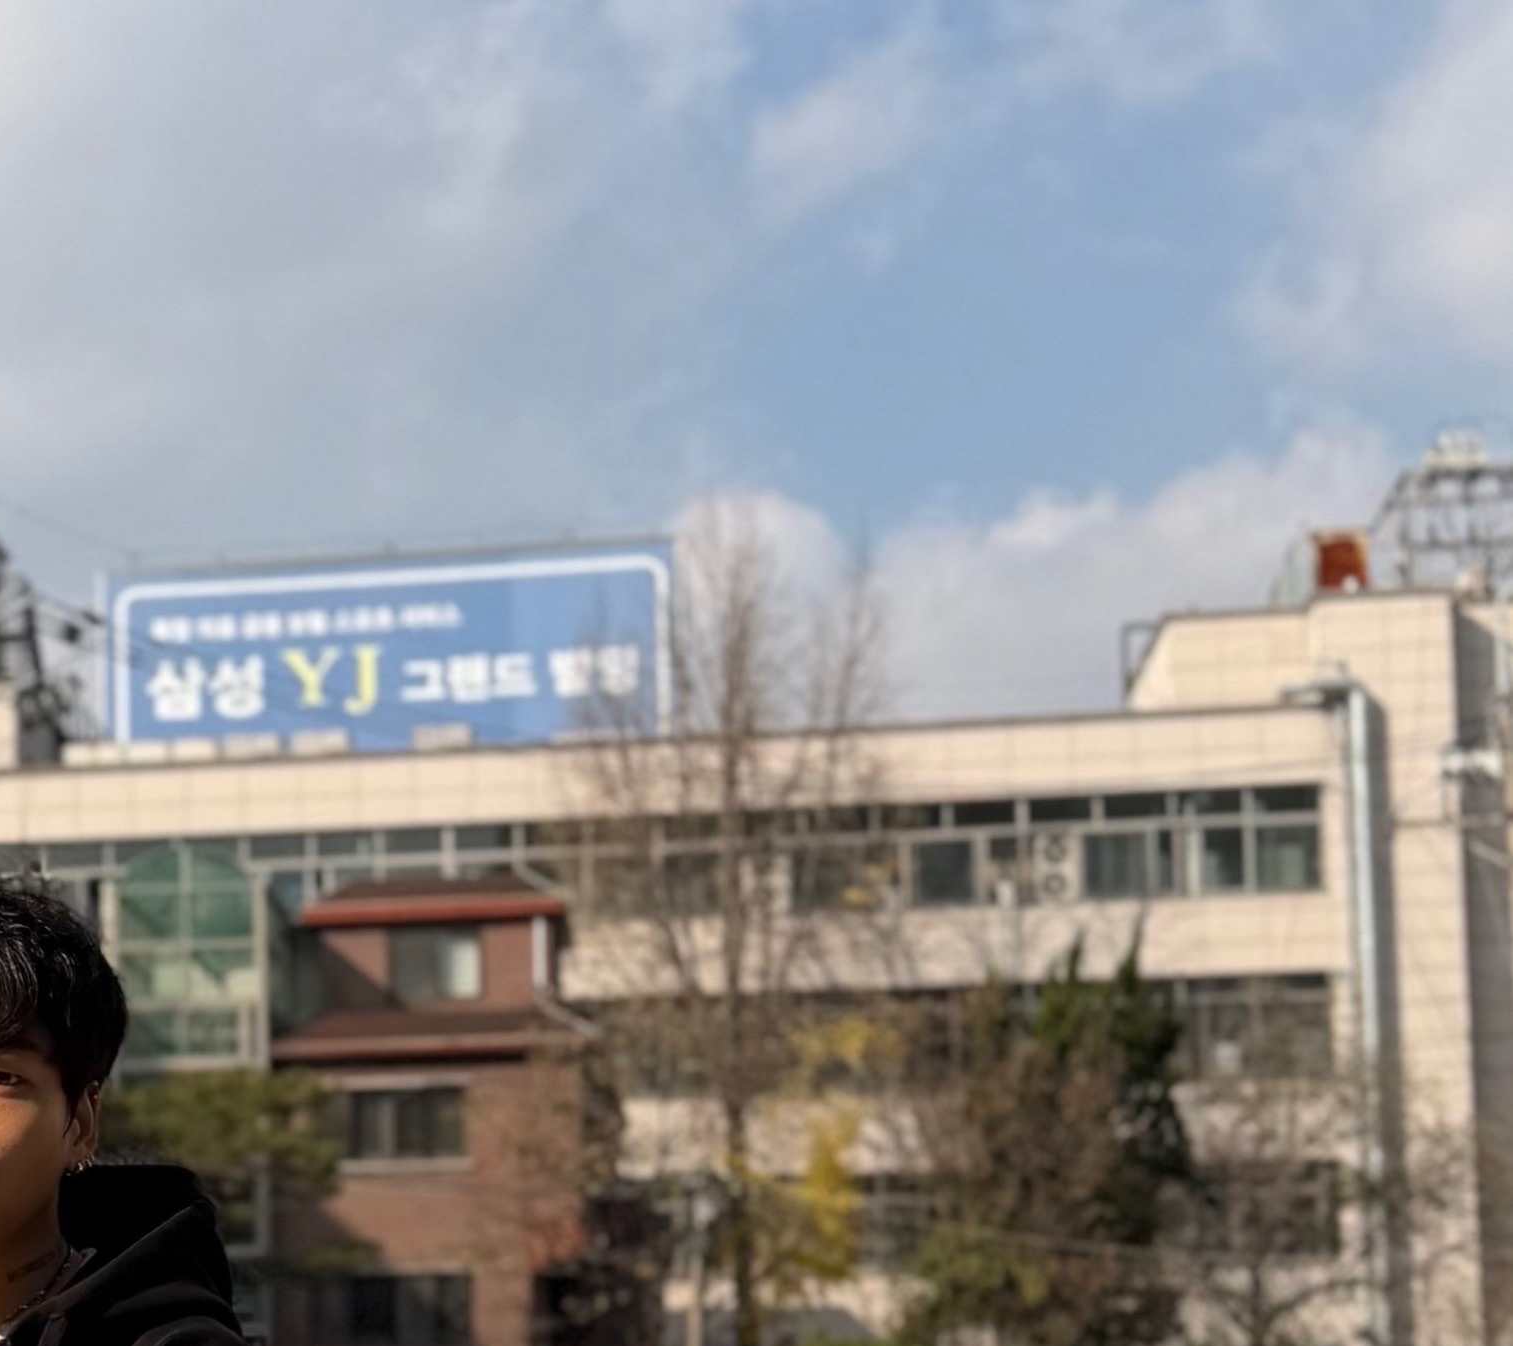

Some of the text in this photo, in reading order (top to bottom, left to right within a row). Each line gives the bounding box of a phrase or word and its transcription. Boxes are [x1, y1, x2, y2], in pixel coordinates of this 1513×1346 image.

[146, 653, 265, 720] 삼성
[282, 644, 380, 715] YJ
[401, 652, 537, 703] 그랜드
